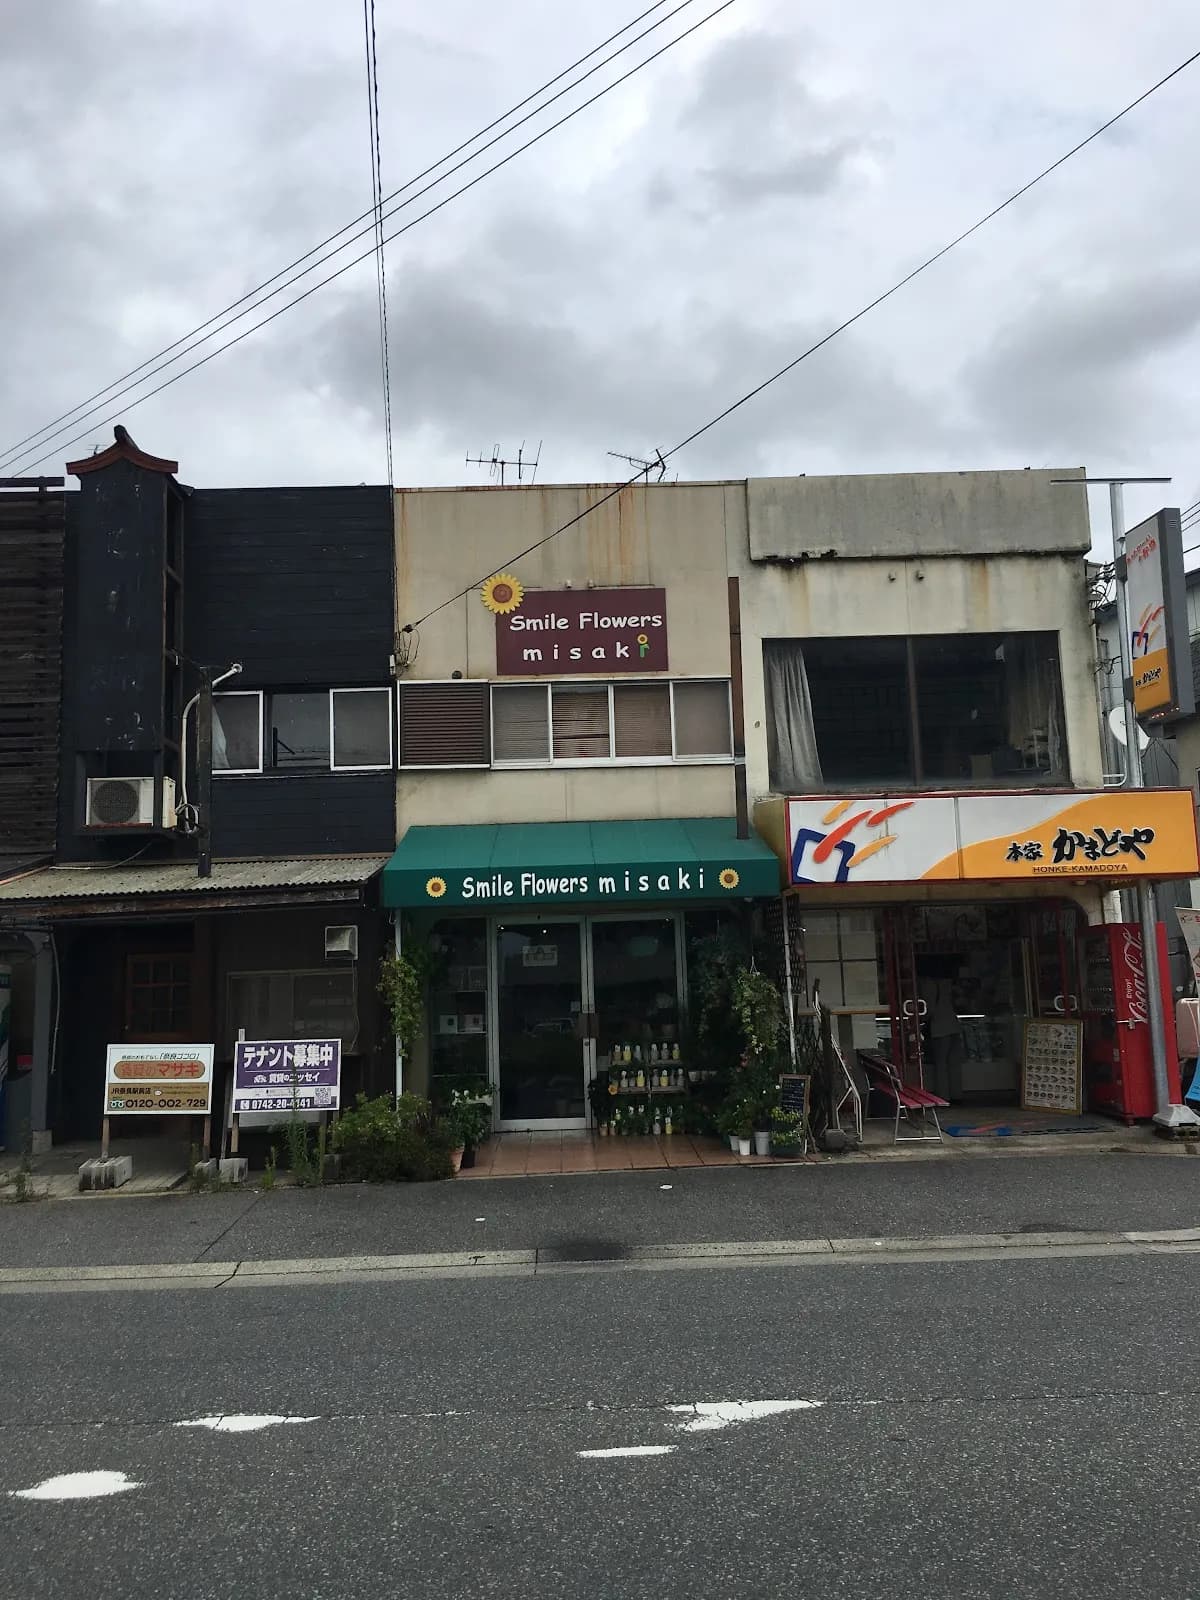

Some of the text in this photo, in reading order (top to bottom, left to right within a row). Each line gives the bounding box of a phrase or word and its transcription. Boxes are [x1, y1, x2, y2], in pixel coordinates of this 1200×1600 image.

[509, 612, 663, 631] Smile Flowers
[1005, 827, 1155, 863] 本家 かまどや
[1032, 863, 1128, 874] HONKE-KAMADOYA
[462, 867, 705, 899] Smile Flowers misaki
[243, 1043, 334, 1068] テナント募集中
[125, 1098, 207, 1108] 0120-002-729
